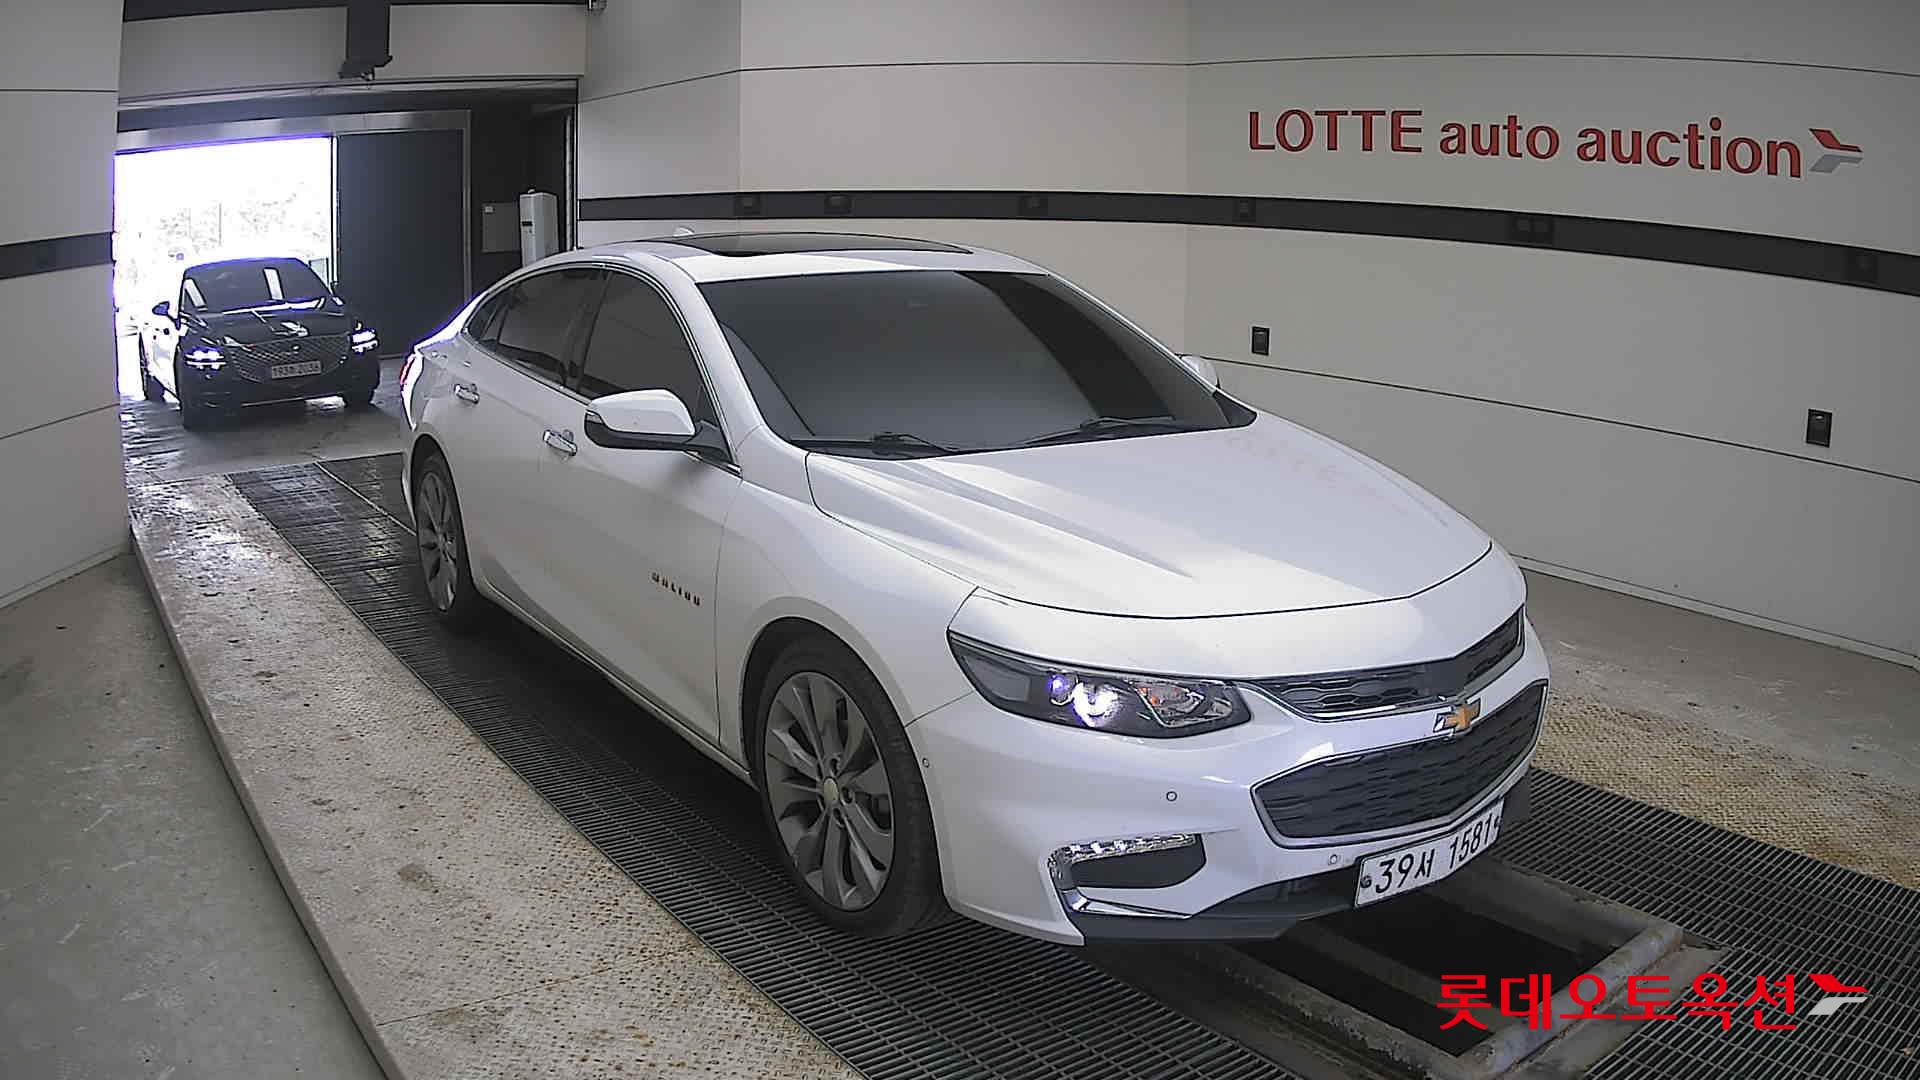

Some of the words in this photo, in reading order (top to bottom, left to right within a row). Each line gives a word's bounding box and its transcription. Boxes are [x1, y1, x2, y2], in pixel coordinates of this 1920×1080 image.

[1247, 109, 1423, 153] LOTTE
[1438, 115, 1560, 160] auto
[1576, 116, 1802, 179] auction
[1375, 848, 1435, 893] 39서
[1449, 812, 1493, 870] 1581
